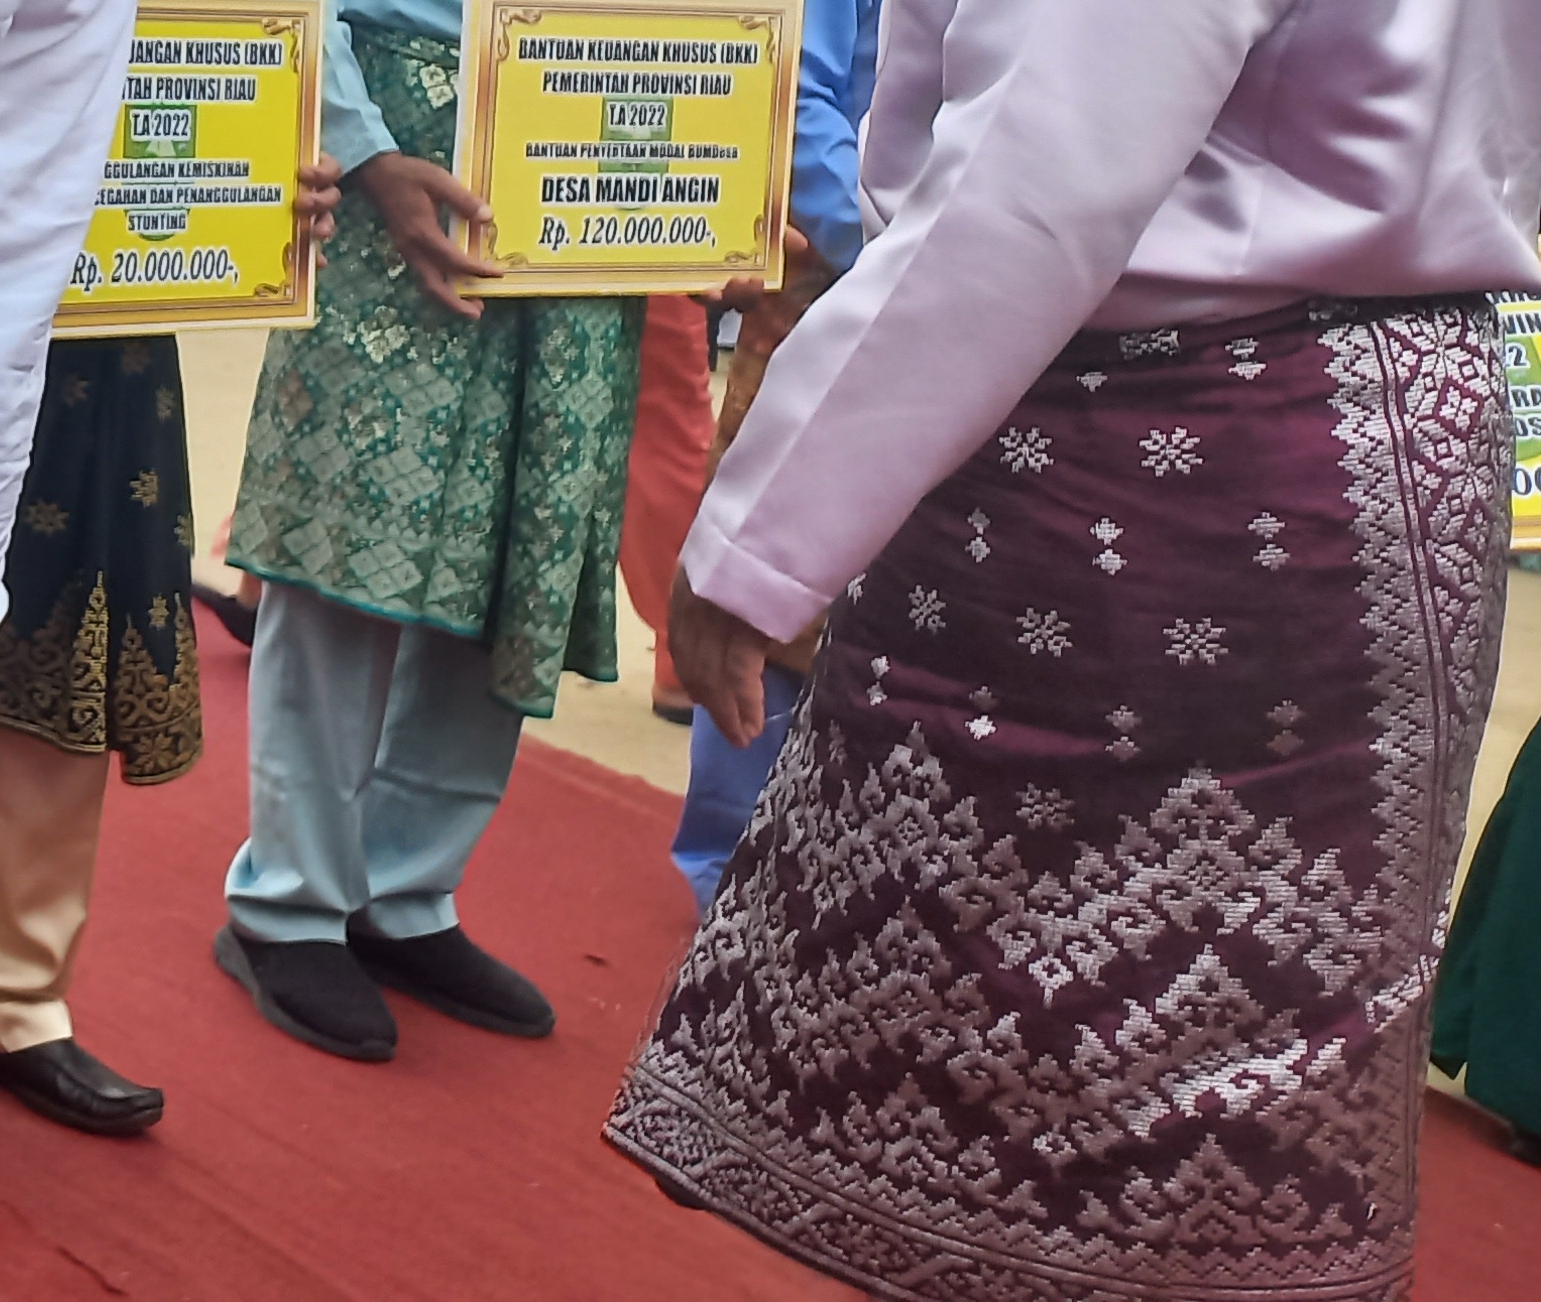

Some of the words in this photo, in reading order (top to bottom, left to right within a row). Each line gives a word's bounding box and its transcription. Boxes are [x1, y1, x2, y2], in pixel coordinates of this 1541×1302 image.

[185, 41, 240, 65] KHUSUS
[245, 42, 282, 66] (BKK)
[518, 37, 583, 61] BANTUAN
[588, 38, 659, 62] KEUANGAN
[662, 40, 717, 63] KHUSUS
[721, 42, 758, 65] (BKK)
[156, 77, 221, 100] PROVINSI
[225, 78, 256, 101] RIAU
[542, 71, 629, 94] PEMERINTAH
[632, 72, 697, 95] PROVINSI
[700, 74, 732, 96] RIAU
[153, 113, 189, 136] 2022
[629, 104, 666, 126] 2022
[526, 142, 578, 158] BANTUAN
[649, 143, 685, 158] MODAL
[104, 161, 175, 179] GGULANGAN
[178, 161, 250, 178] KEMISKINAN
[95, 187, 146, 205] EGAHAN
[150, 187, 173, 204] DAN
[176, 186, 281, 204] PENANGGULANGAN
[541, 177, 590, 203] DESA
[595, 177, 658, 203] MANDI
[662, 177, 719, 203] ANGIN
[128, 213, 186, 231] STUNTING
[539, 216, 570, 251] Rp.
[70, 253, 103, 292] Rp.
